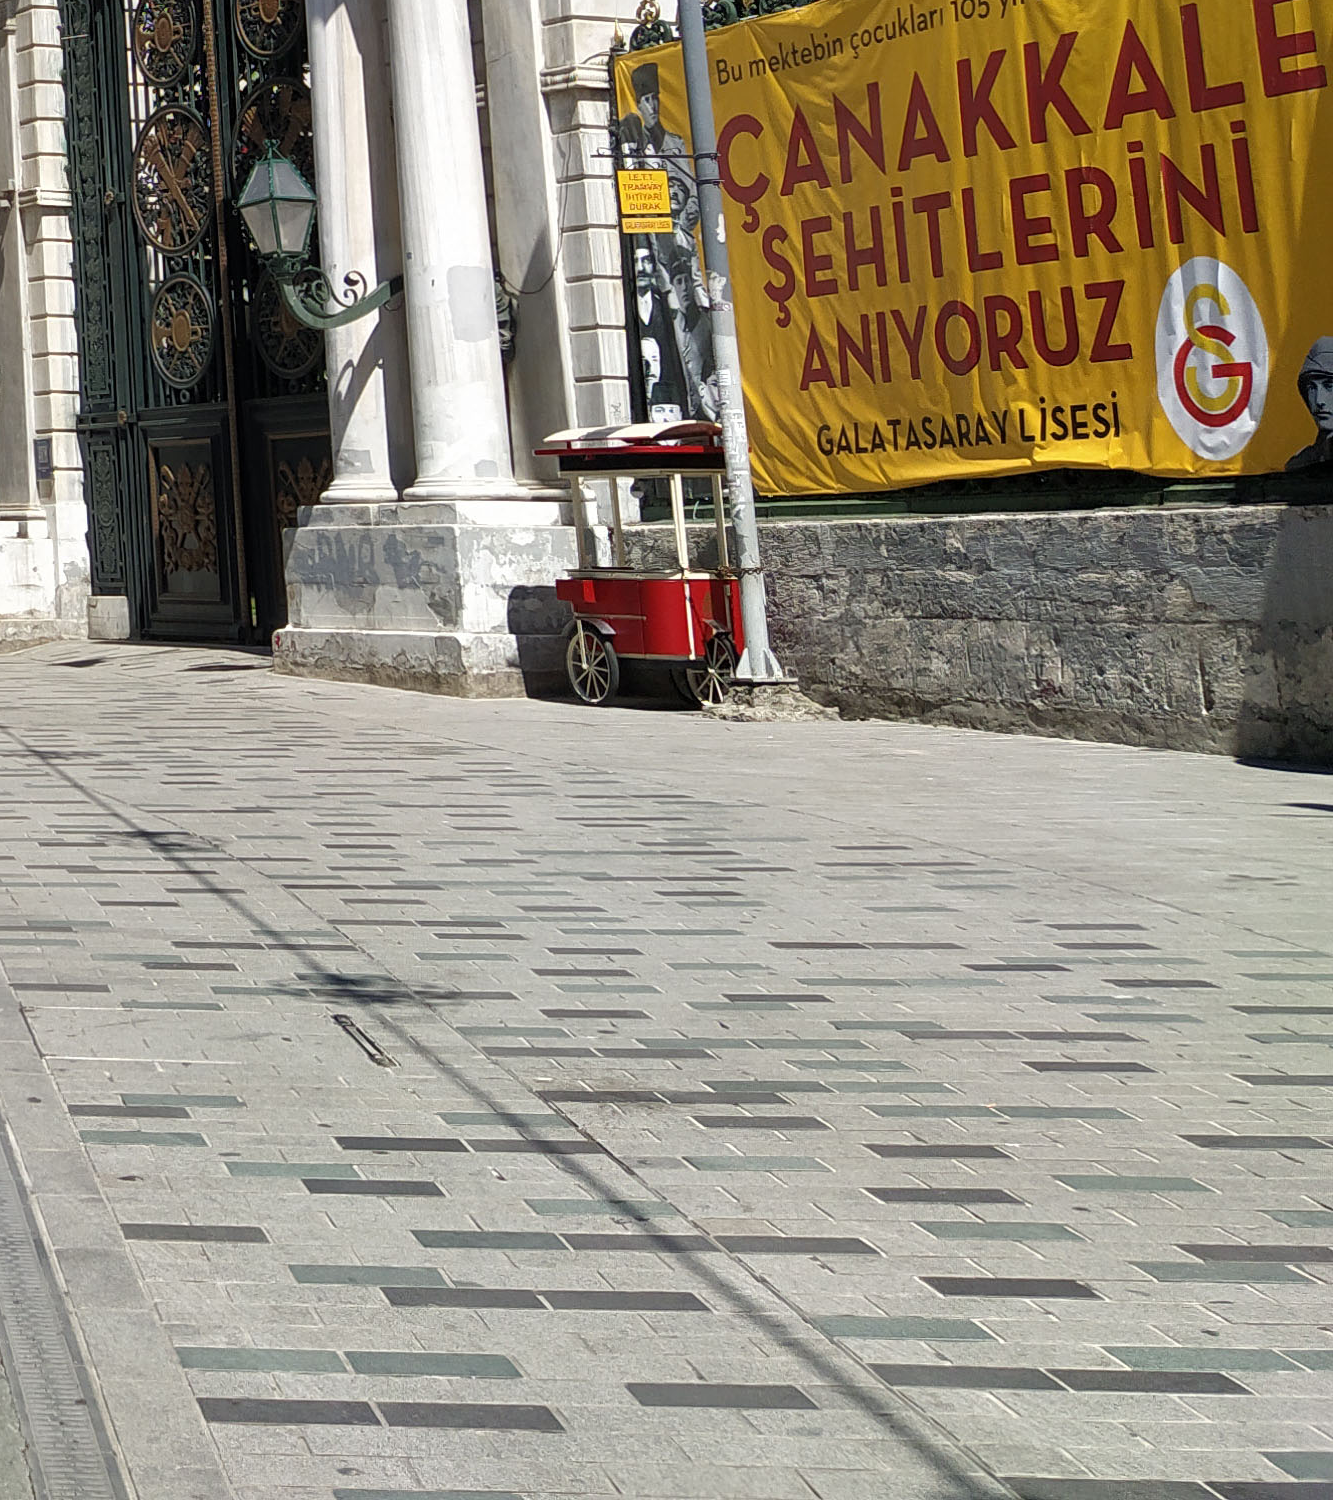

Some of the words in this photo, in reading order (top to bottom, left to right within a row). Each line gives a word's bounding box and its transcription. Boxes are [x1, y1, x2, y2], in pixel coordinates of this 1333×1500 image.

[715, 58, 743, 86] Bu
[748, 33, 844, 78] mektebin
[849, 3, 944, 59] çocukları
[629, 203, 662, 211] DURAK
[761, 119, 1260, 328] ŞEHİTLERİNİ
[799, 279, 1134, 391] ANIYORUZ
[816, 409, 1008, 457] GALATASARAY
[1019, 390, 1122, 443] LİSESİ
